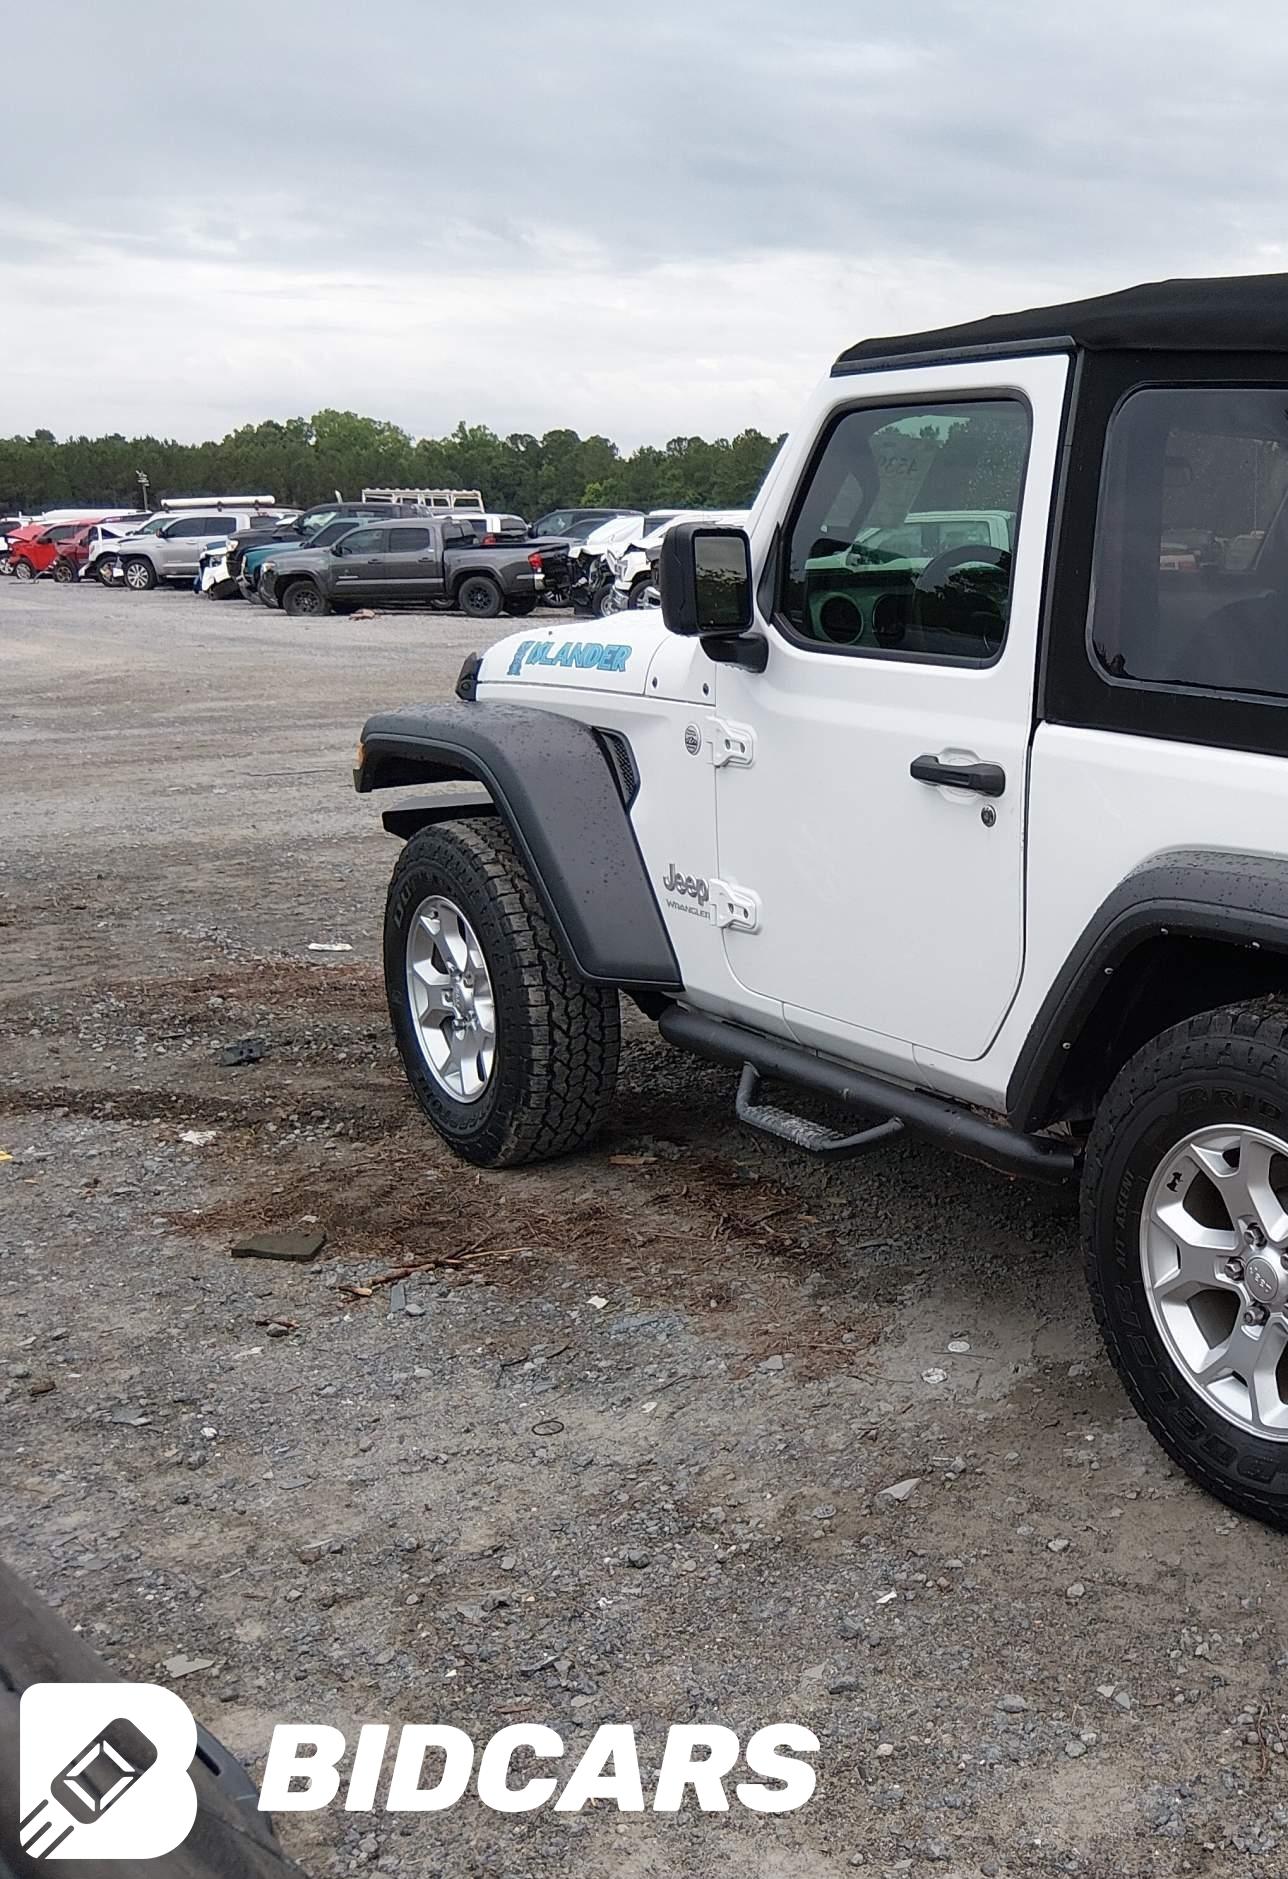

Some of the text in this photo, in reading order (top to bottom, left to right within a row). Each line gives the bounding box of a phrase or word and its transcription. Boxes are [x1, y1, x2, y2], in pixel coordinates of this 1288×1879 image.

[507, 640, 632, 676] ISLANDER
[663, 863, 710, 907] Jeep
[665, 898, 712, 921] WRANGLER
